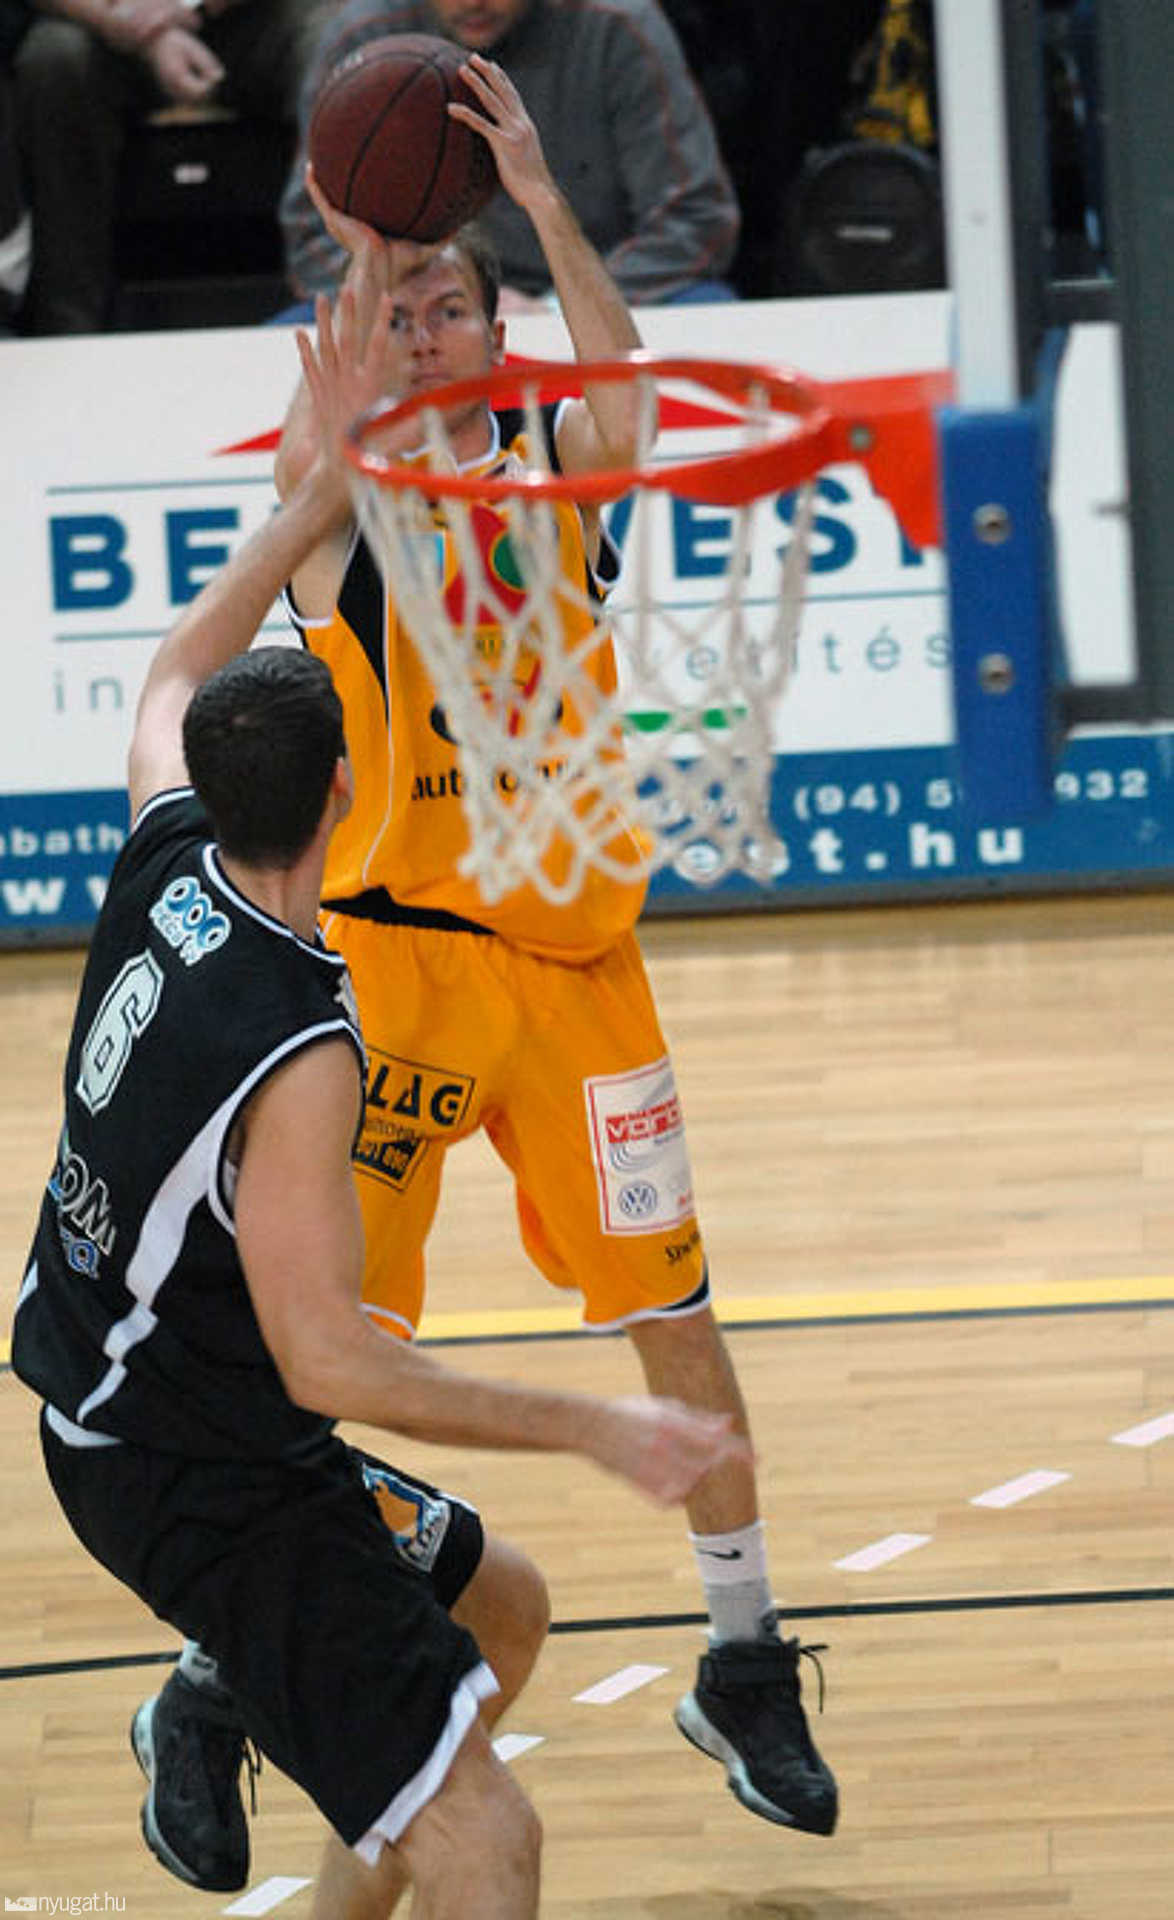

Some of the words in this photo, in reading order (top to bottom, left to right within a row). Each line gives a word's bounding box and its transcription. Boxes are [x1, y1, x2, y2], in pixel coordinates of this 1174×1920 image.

[0, 822, 127, 857] bath
[793, 781, 901, 822] (94)
[1053, 768, 1149, 802] 932
[74, 945, 165, 1118] 6
